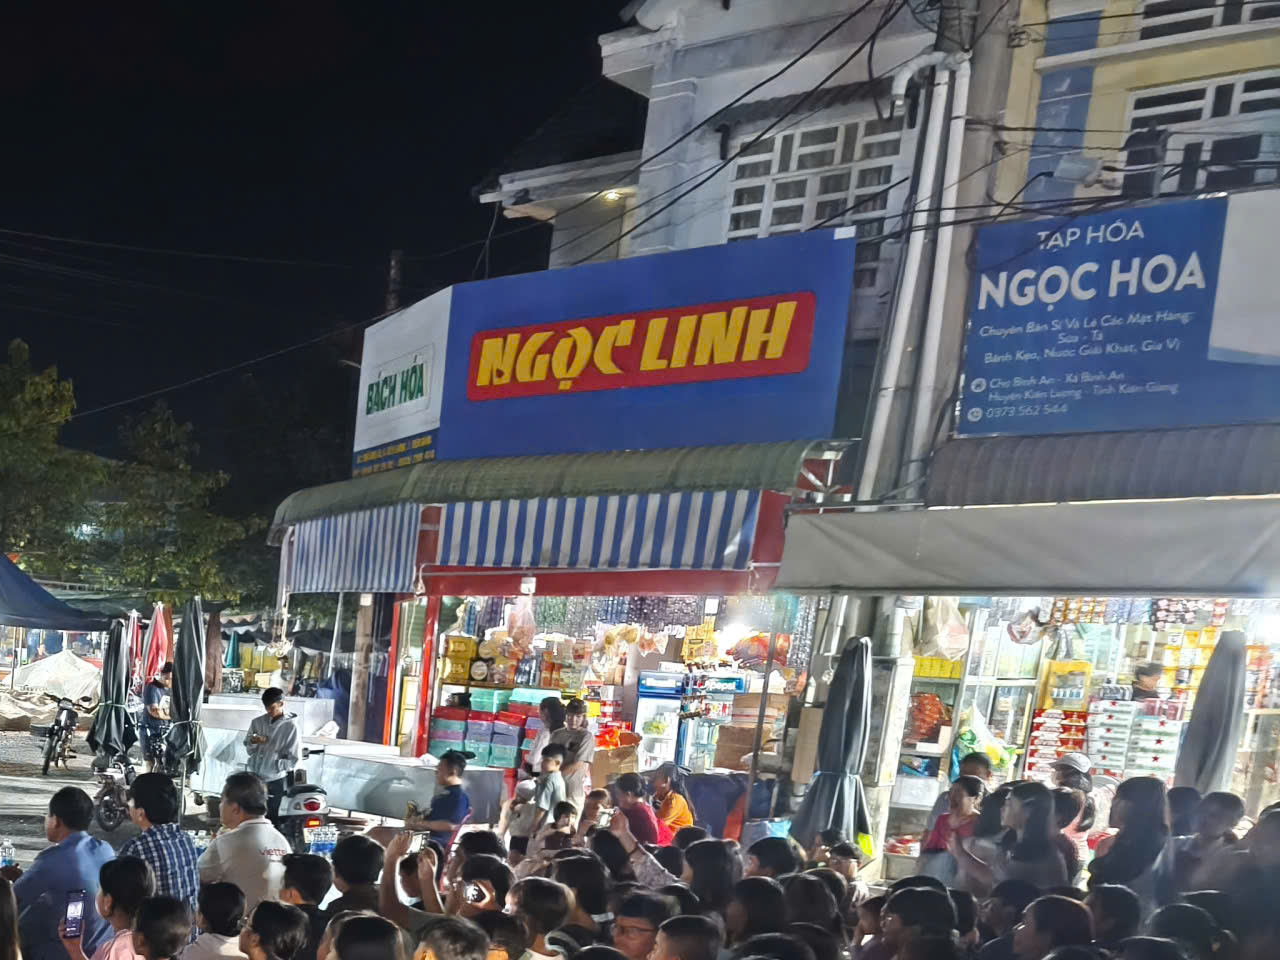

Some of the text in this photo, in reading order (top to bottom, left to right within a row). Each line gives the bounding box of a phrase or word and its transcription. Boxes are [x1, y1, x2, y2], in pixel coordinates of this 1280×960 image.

[1036, 227, 1081, 252] TẠP
[978, 250, 1206, 311] NGỌC HOA
[476, 300, 798, 391] NGỌC LINH
[366, 370, 397, 415] BÁCH
